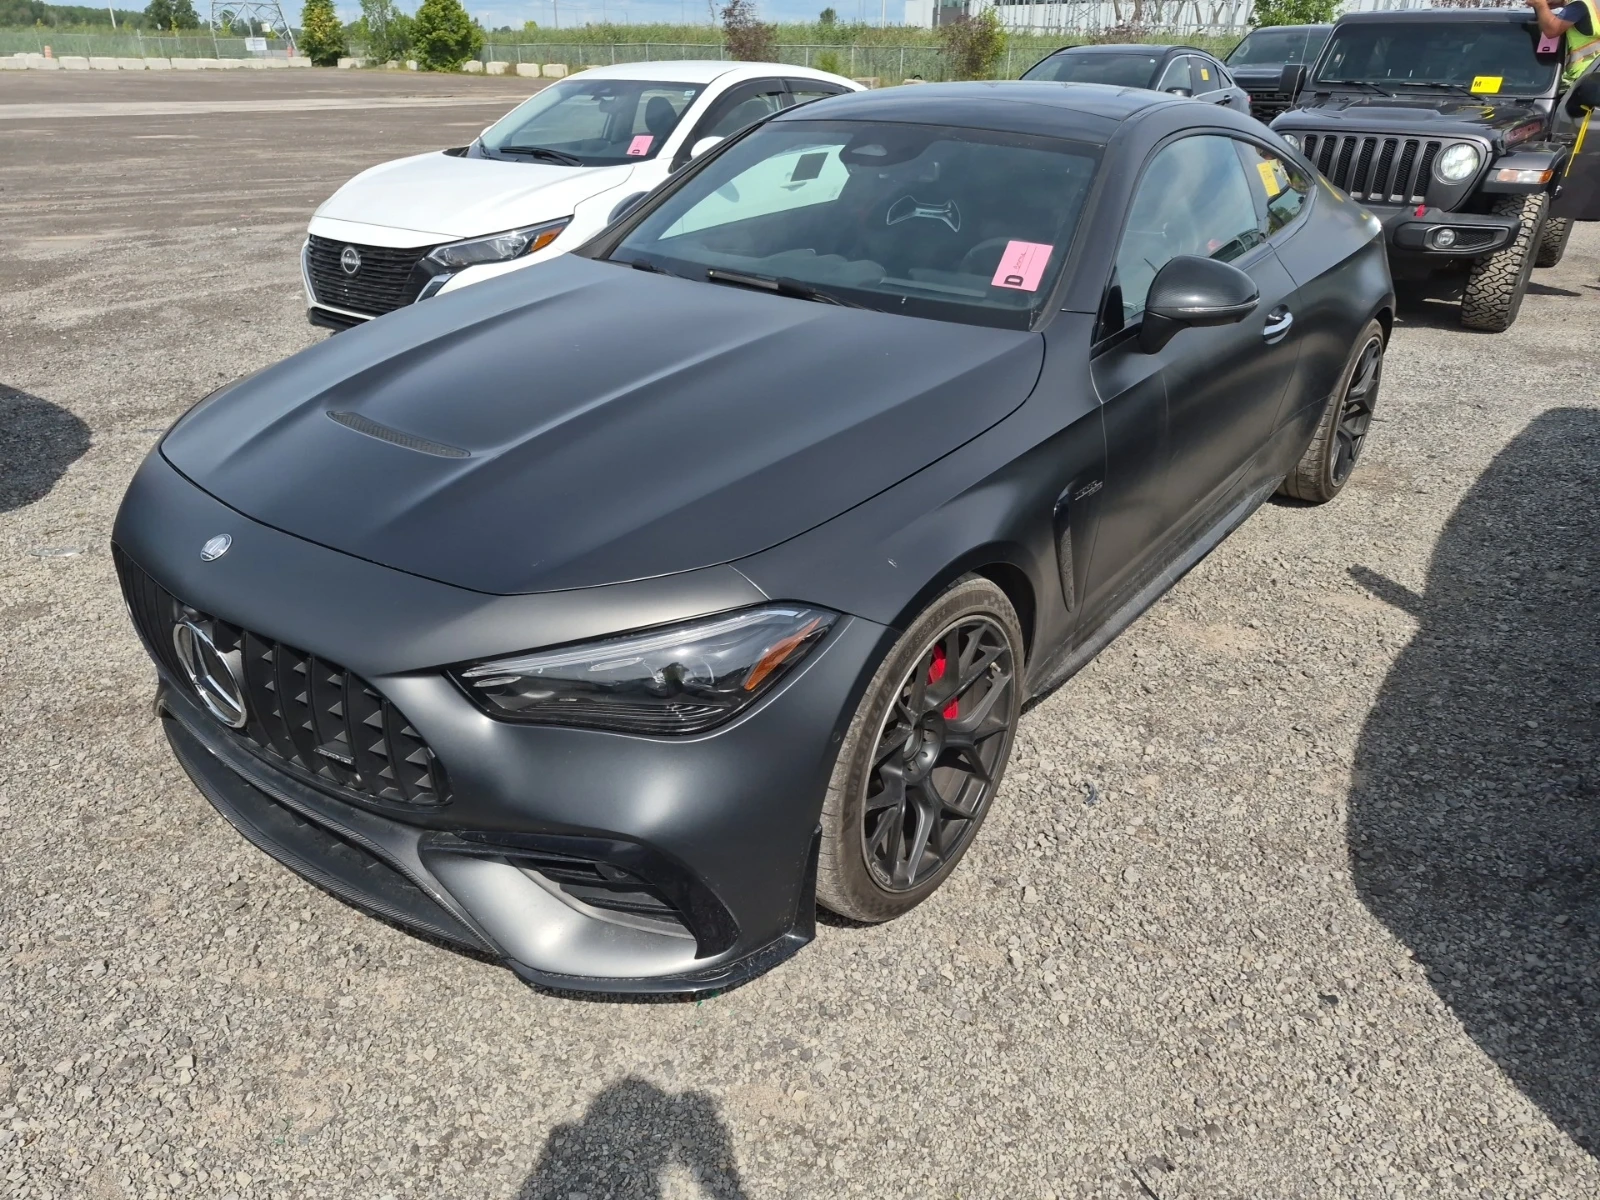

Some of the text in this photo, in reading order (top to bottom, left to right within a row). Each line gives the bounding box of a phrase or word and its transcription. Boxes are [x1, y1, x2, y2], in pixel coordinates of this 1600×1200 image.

[1003, 274, 1024, 287] D
[914, 616, 936, 646] SPORT
[849, 677, 894, 797] MICHELIN
